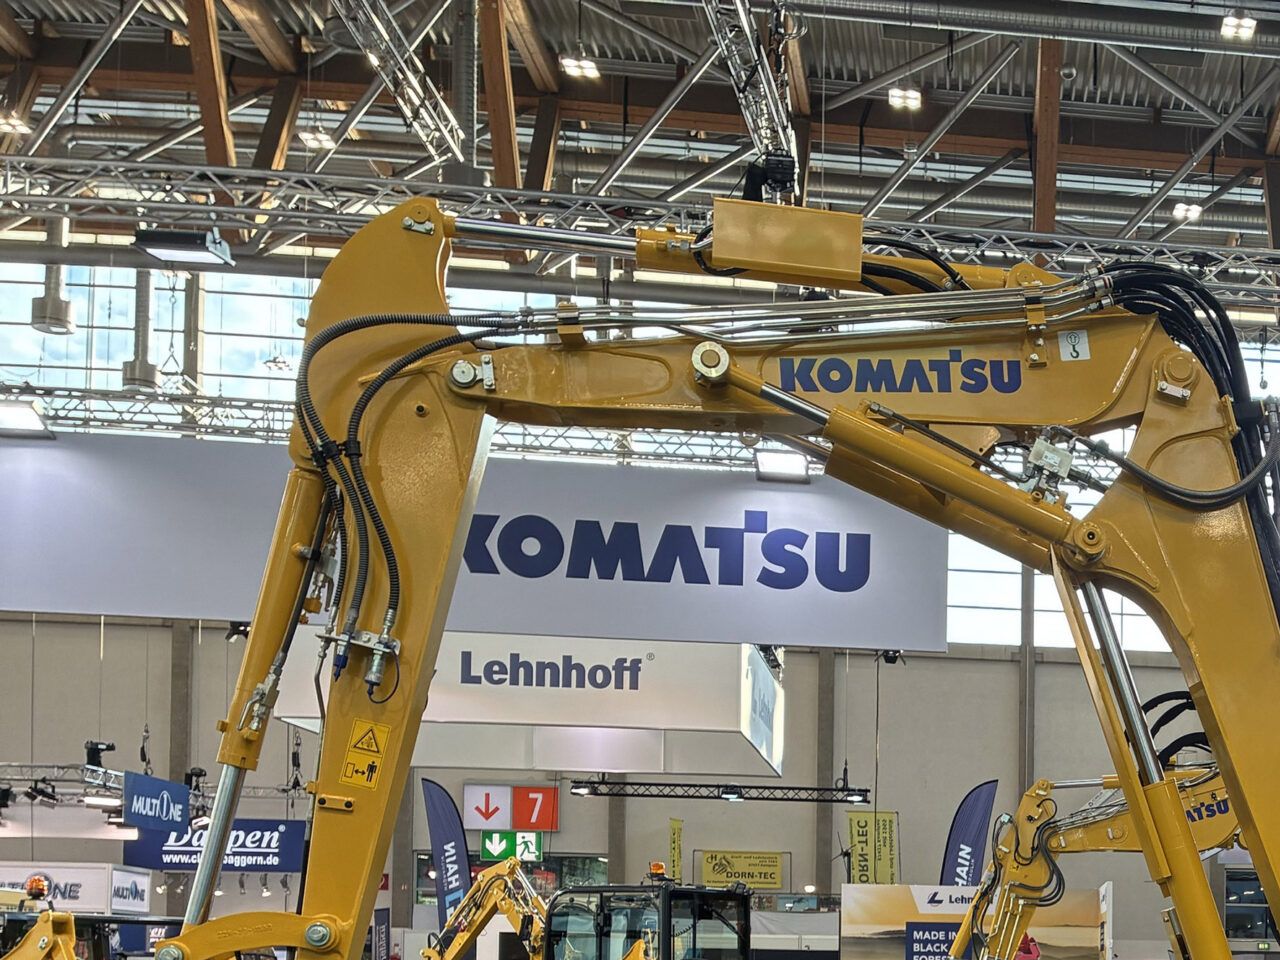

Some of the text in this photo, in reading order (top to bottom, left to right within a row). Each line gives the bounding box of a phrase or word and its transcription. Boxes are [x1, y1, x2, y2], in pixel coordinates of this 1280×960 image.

[779, 349, 1022, 393] KOMATSU
[460, 651, 642, 691] Lehnhoff
[528, 793, 544, 824] 7
[1186, 800, 1230, 822] ATSU
[726, 871, 776, 880] DORN-TEC
[913, 931, 946, 940] MADE
[913, 943, 949, 953] BLACK
